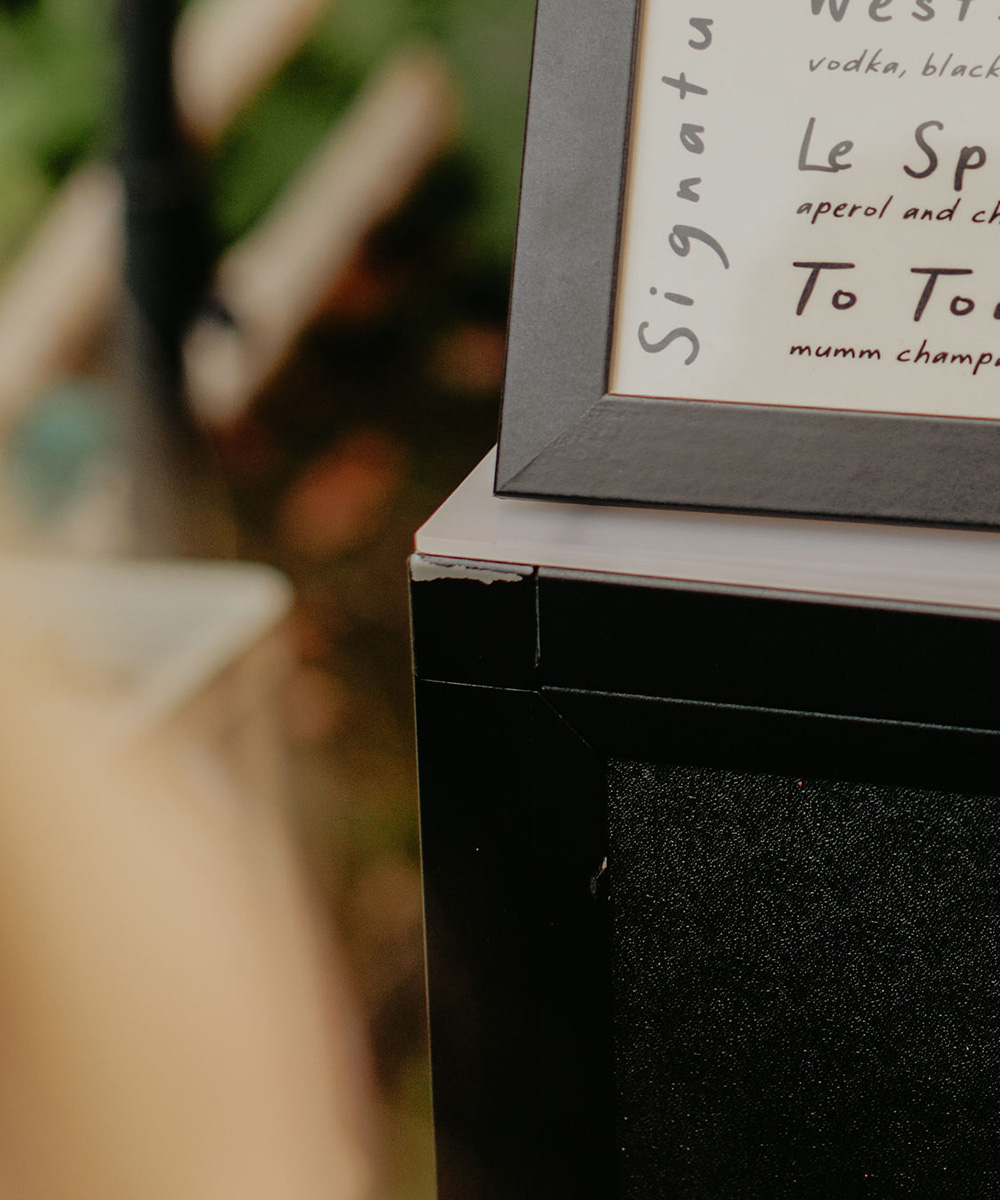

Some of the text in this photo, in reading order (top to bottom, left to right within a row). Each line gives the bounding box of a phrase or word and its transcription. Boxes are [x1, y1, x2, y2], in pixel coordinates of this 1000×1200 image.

[809, 49, 907, 79] vodka,
[797, 116, 855, 174] Le
[795, 194, 894, 226] aperol
[902, 197, 962, 222] and
[791, 261, 858, 317] To
[789, 344, 882, 361] mumm
